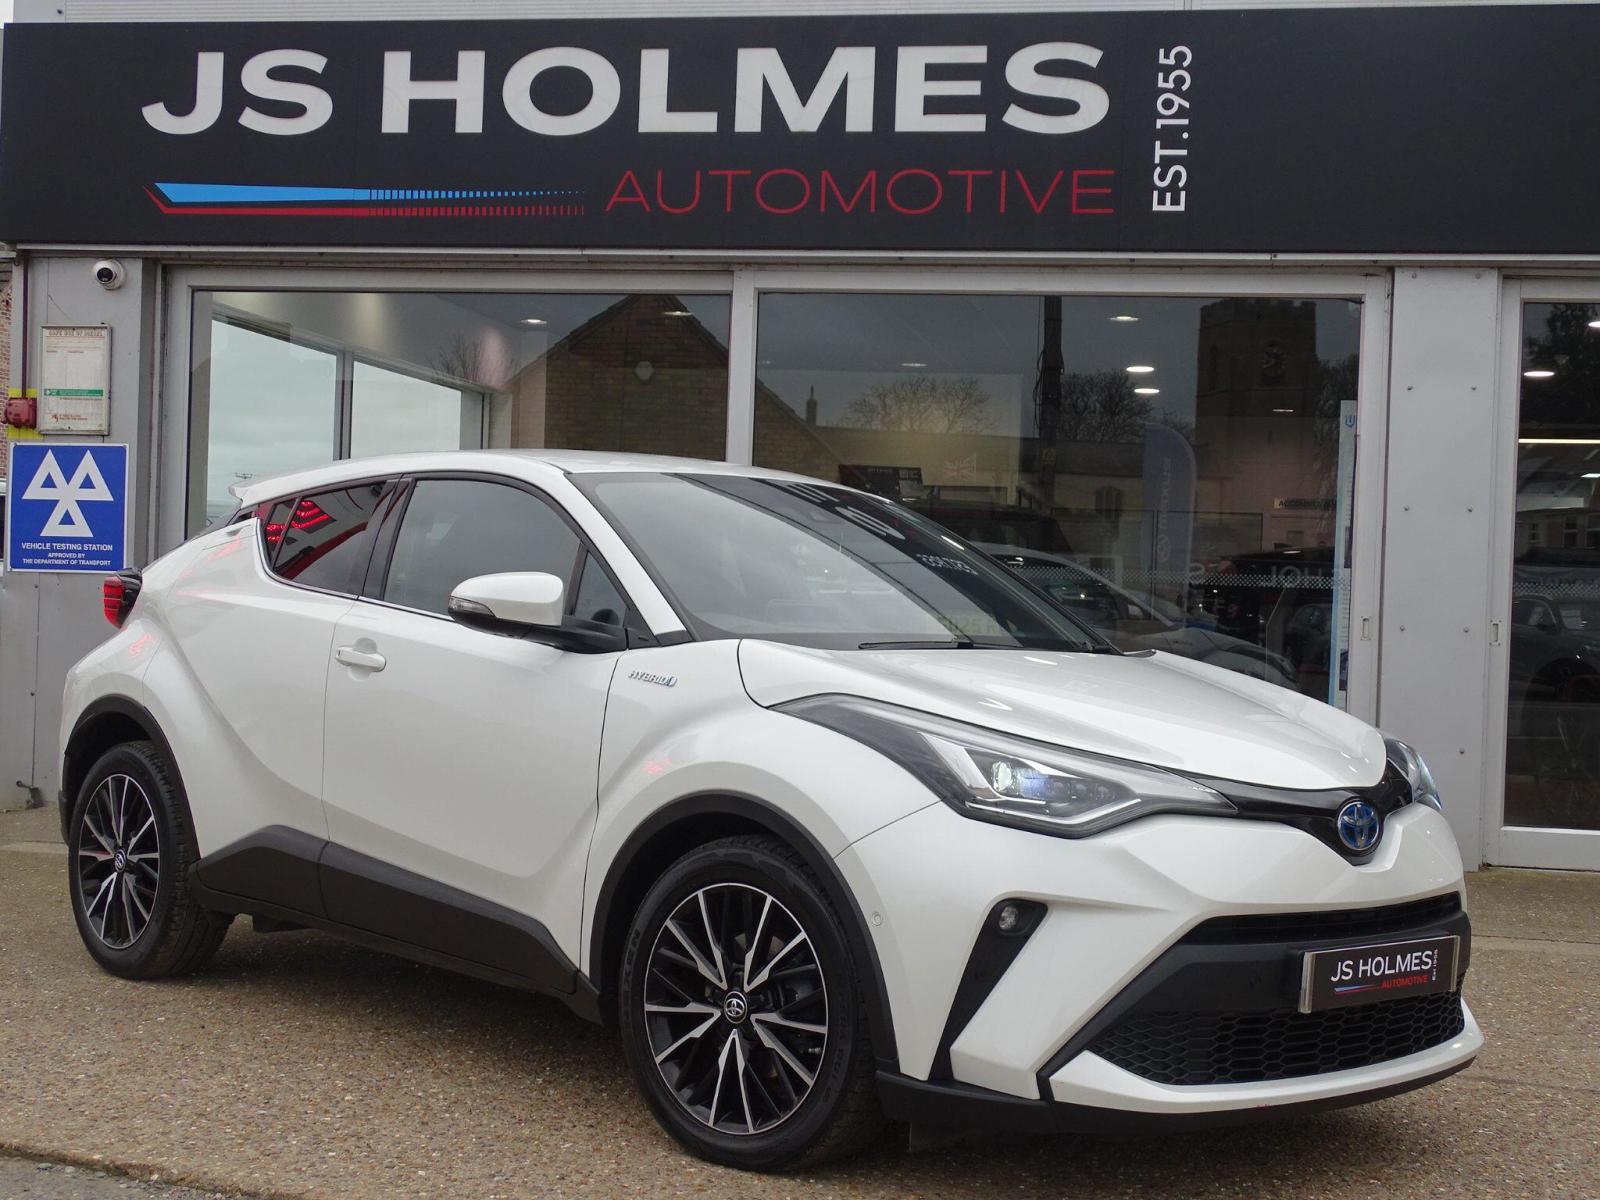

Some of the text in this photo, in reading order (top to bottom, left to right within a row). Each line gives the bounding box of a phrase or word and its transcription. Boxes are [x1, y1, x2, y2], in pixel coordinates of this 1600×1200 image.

[141, 41, 1110, 136] JS HOLMES
[1150, 45, 1193, 213] EST.1955
[604, 168, 1115, 215] AUTOMOTIVE
[21, 542, 51, 550] VEHICLE
[1330, 950, 1433, 982] JS HOLMES
[1381, 974, 1429, 989] AUTOMOTIVE
